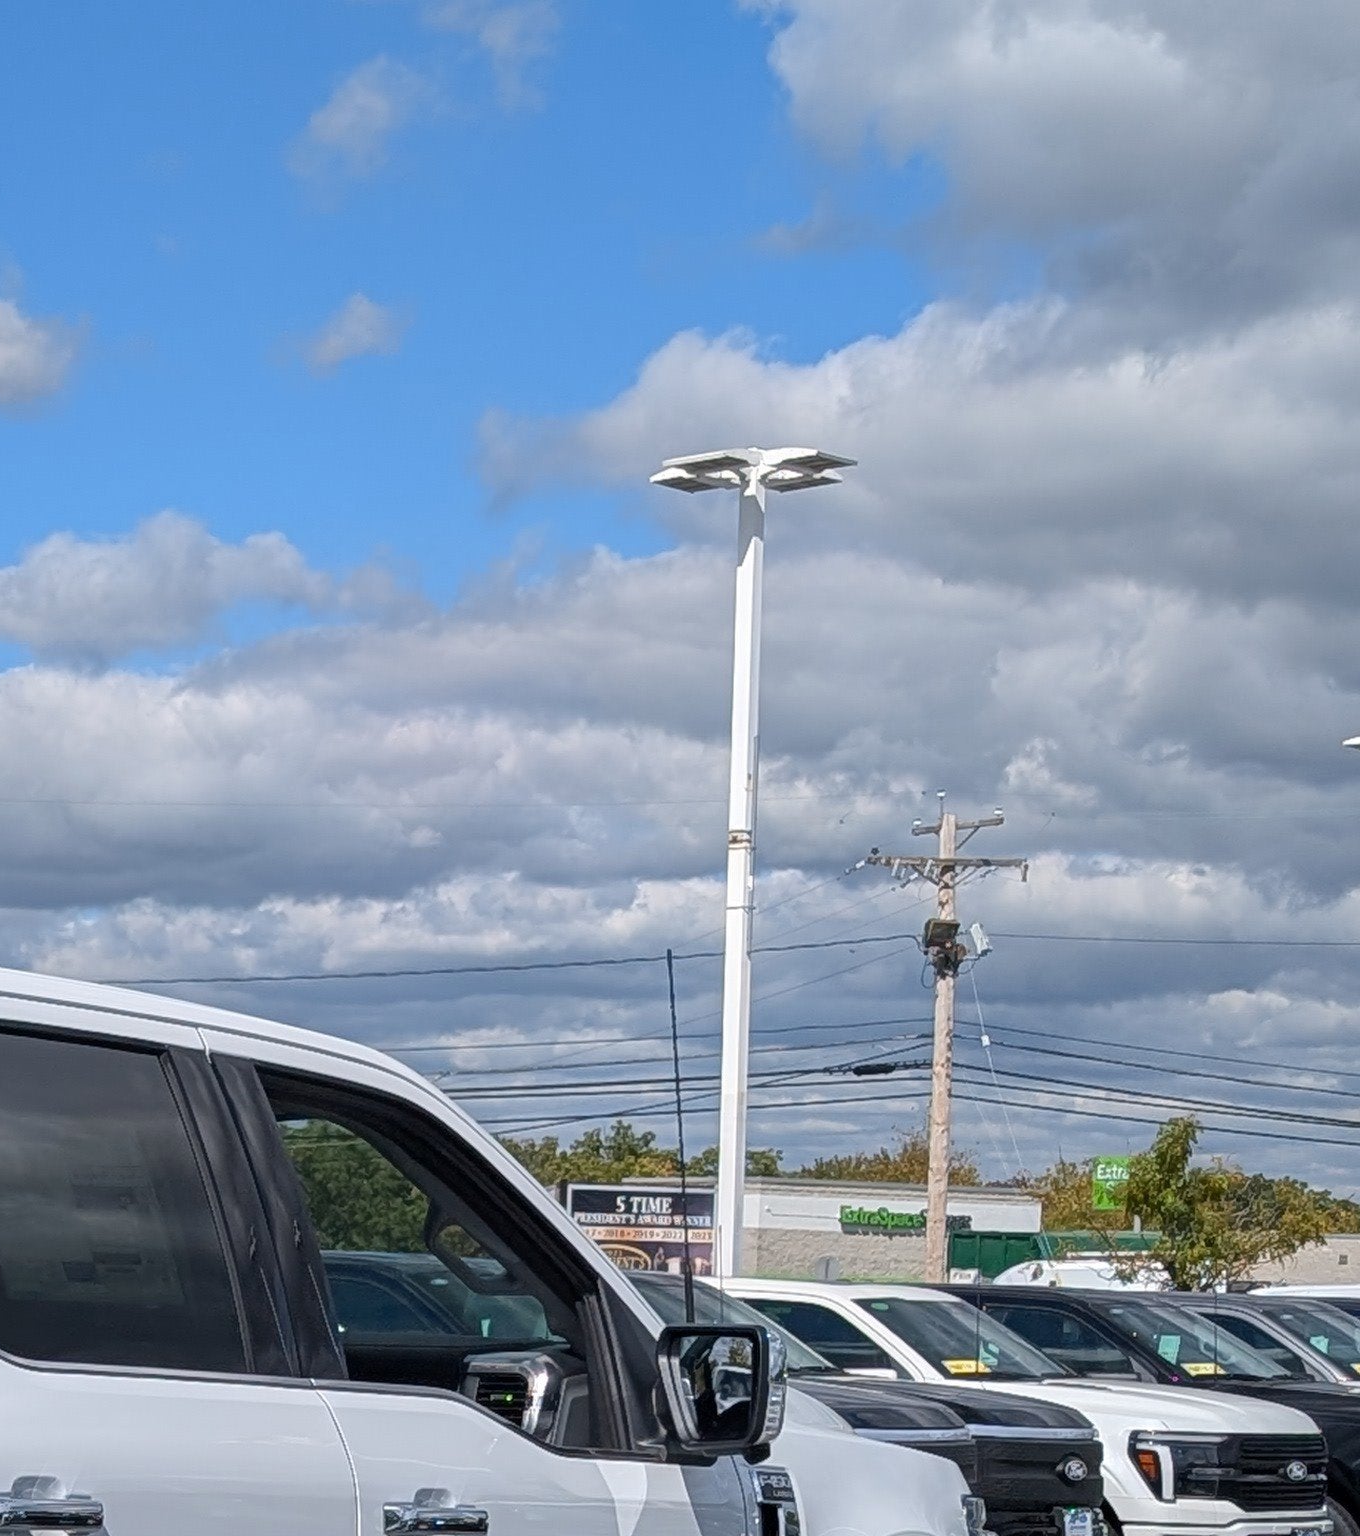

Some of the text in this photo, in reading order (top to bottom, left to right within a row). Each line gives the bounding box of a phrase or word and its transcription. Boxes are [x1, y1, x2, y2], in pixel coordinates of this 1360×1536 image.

[615, 1195, 672, 1214] 5 TIME
[574, 1212, 635, 1225] PRESIDENT'S
[637, 1214, 672, 1226] AWARD
